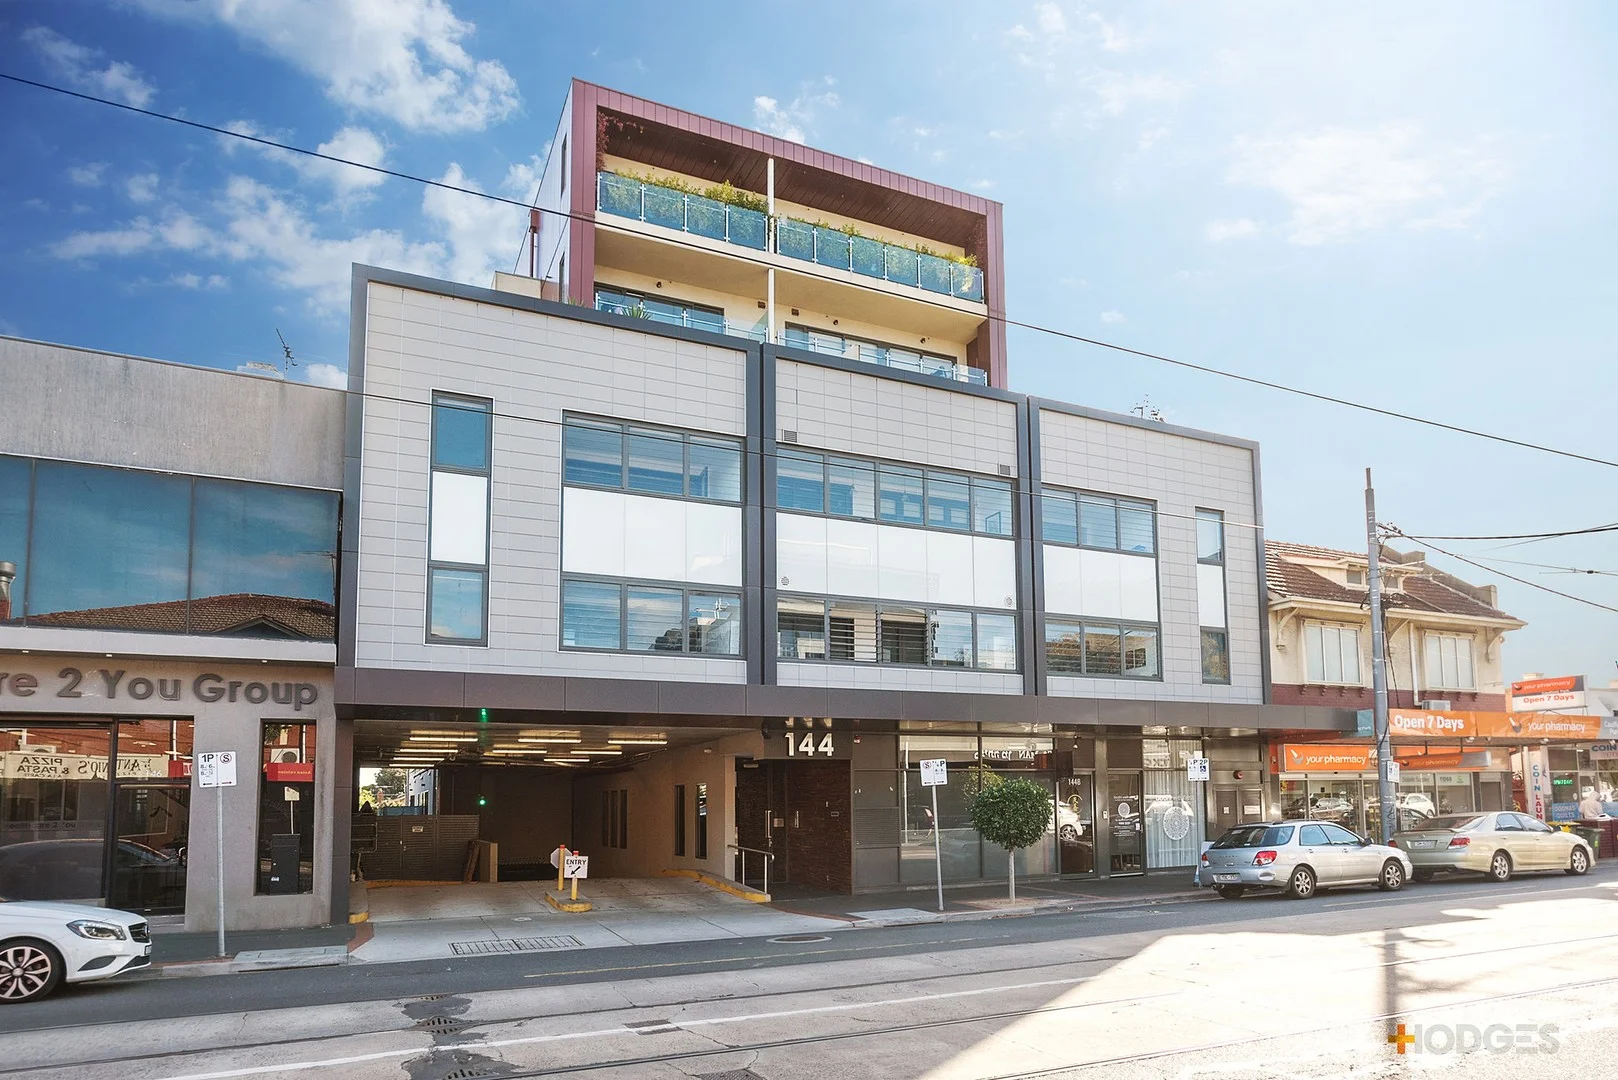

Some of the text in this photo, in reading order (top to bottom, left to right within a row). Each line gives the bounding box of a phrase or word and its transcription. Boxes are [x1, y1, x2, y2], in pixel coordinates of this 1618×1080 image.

[56, 667, 82, 698] 2
[99, 669, 181, 701] You
[193, 673, 318, 711] Group
[1523, 696, 1545, 704] Open
[1554, 694, 1575, 702] Days
[1394, 714, 1465, 732] Open 7 Days
[1528, 721, 1585, 733] your pharmacy
[785, 732, 834, 757] 144
[1591, 744, 1617, 752] COIN
[201, 753, 214, 762] 1P
[1306, 754, 1366, 765] your pharmacy
[1532, 765, 1540, 791] COIN
